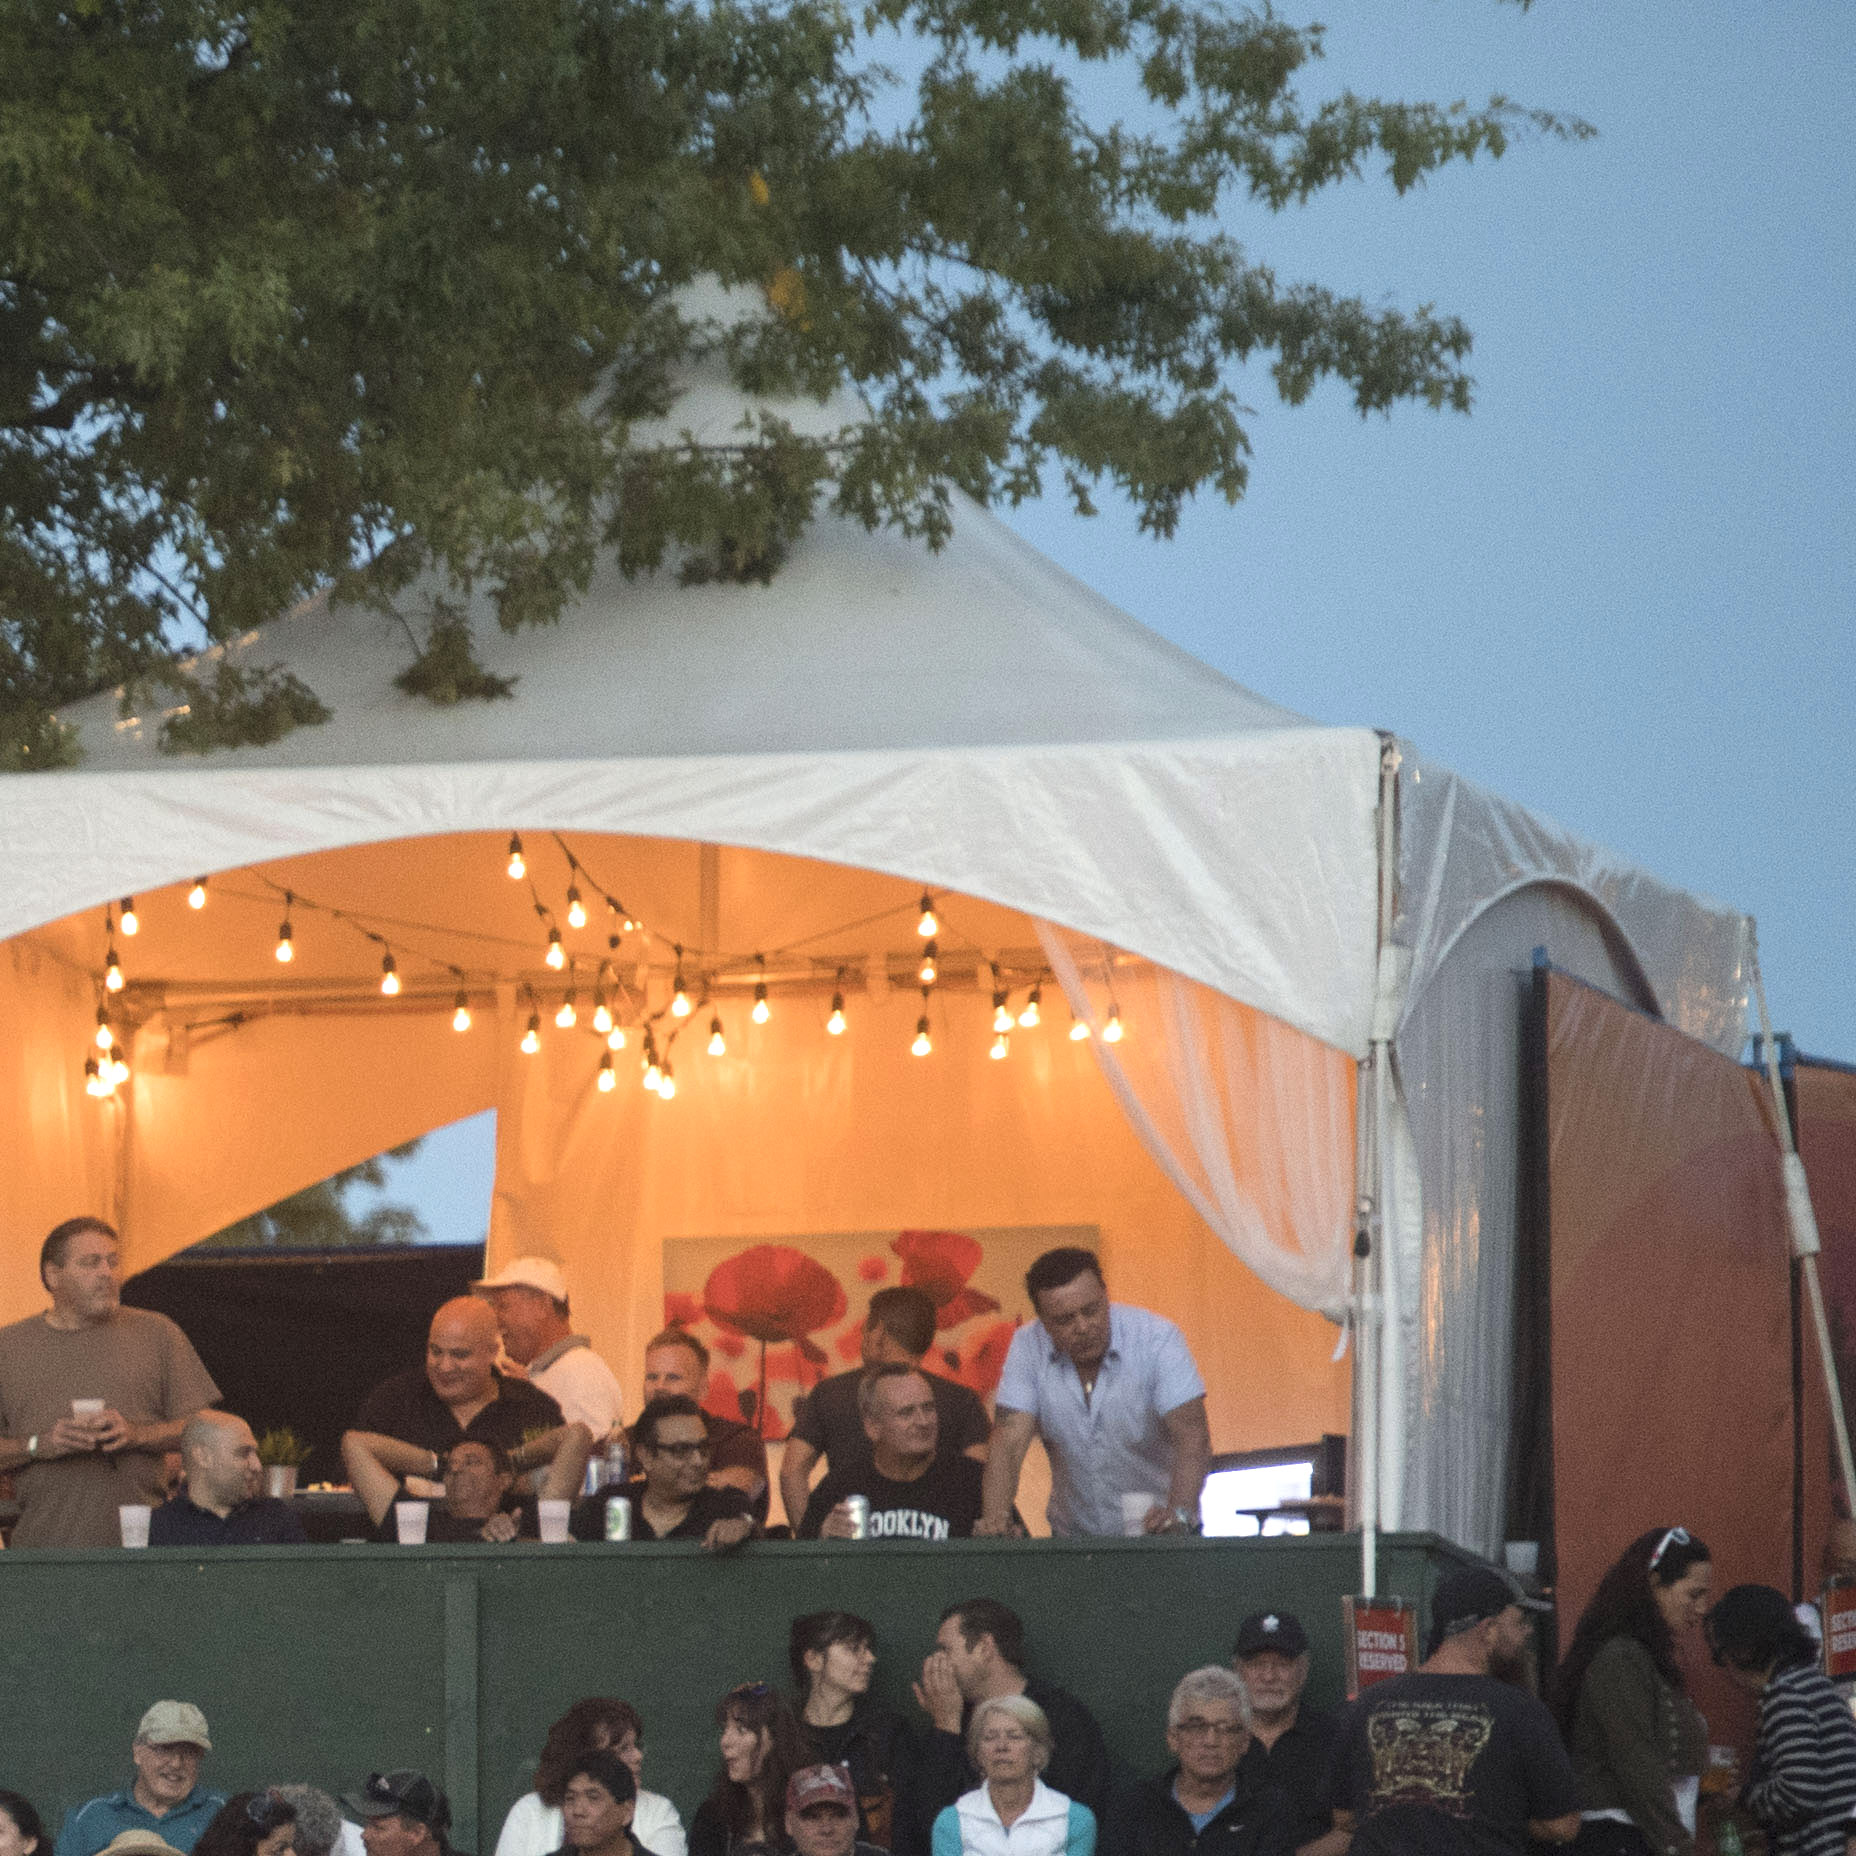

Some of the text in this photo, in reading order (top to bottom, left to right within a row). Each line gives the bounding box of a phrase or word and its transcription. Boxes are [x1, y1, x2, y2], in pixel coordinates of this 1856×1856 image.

[870, 1509, 949, 1541] OOKLYN
[1357, 1630, 1406, 1652] SECTION 5
